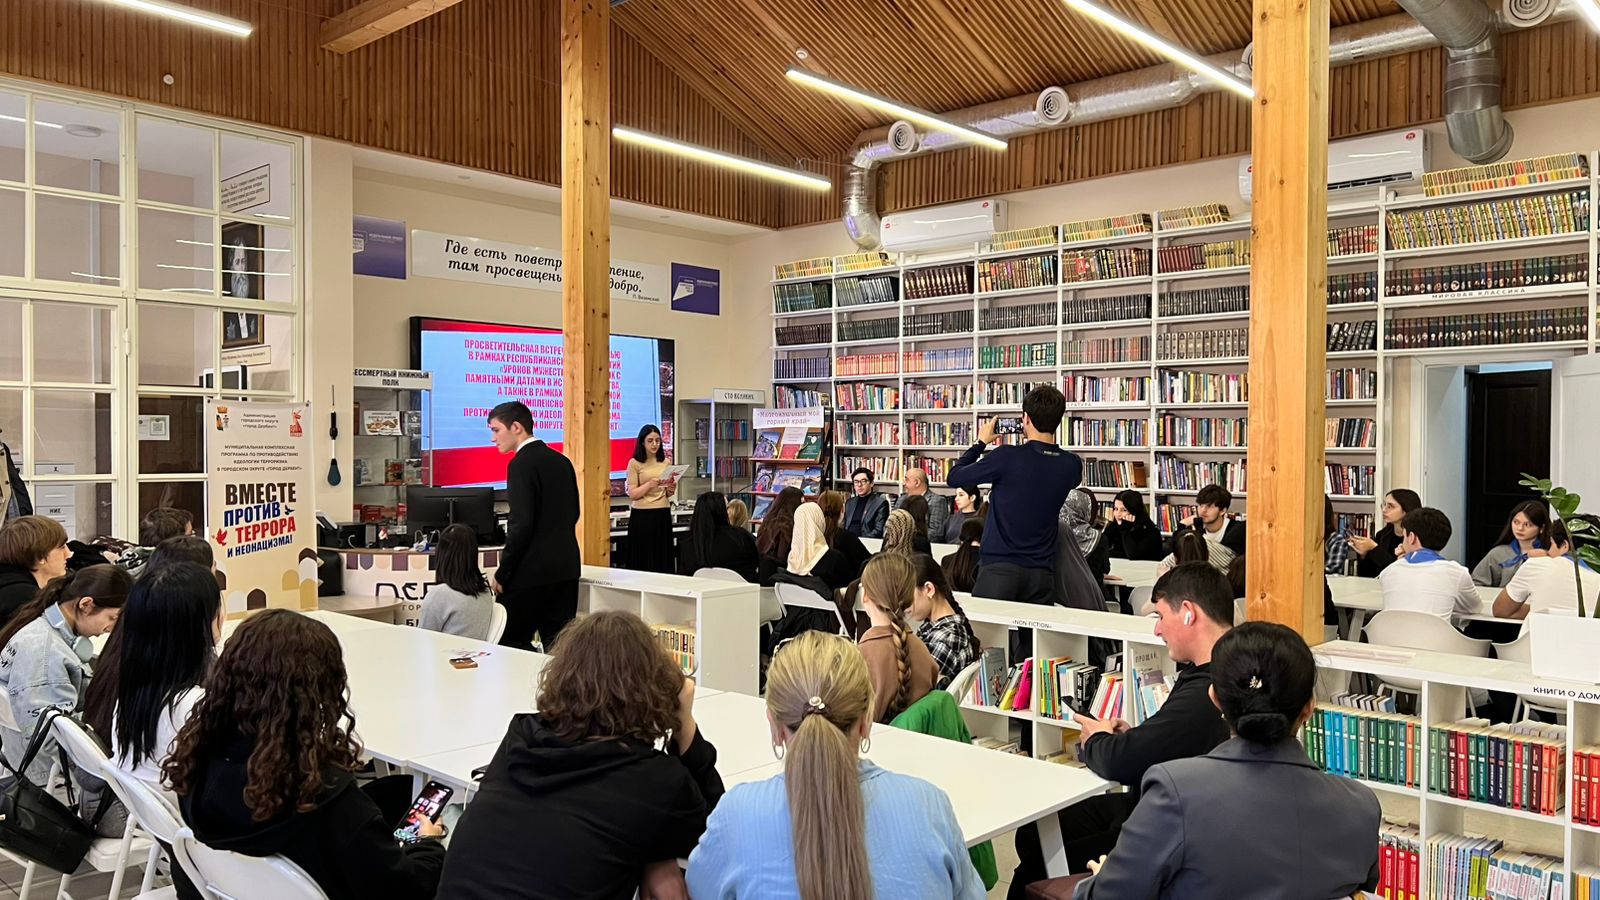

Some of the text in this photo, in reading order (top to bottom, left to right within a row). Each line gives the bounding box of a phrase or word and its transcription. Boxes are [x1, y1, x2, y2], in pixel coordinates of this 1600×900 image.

[445, 239, 644, 280] Где есть поветр тение,
[448, 260, 479, 272] там
[485, 264, 562, 283] просвещень
[1432, 288, 1525, 299] МИРОВАЯ КЛАССИКА
[464, 339, 539, 354] ПРОСВЕТИТЕЛЬСКАЯ
[468, 351, 474, 360] В
[475, 351, 505, 362] РАМКАХ
[353, 368, 430, 379] ЕССМЕРТНЫЙ КНИЖНЫЙ
[465, 373, 515, 385] ПАМЯТНЫМИ
[516, 376, 546, 387] ДАТАМИ
[547, 377, 552, 386] В
[497, 386, 563, 397] А ТАКЖЕ В РАМКАХ
[724, 392, 733, 400] СТО
[516, 398, 564, 408] ОМПЛЕКСНО
[225, 482, 297, 506] ВМЕСТЕ
[224, 501, 281, 528] ПРОТИВ
[235, 515, 296, 544] ТЕРРОРА
[227, 534, 293, 558] И НЕОНАЦИЗМА!
[1533, 686, 1565, 696] КНИГИ
